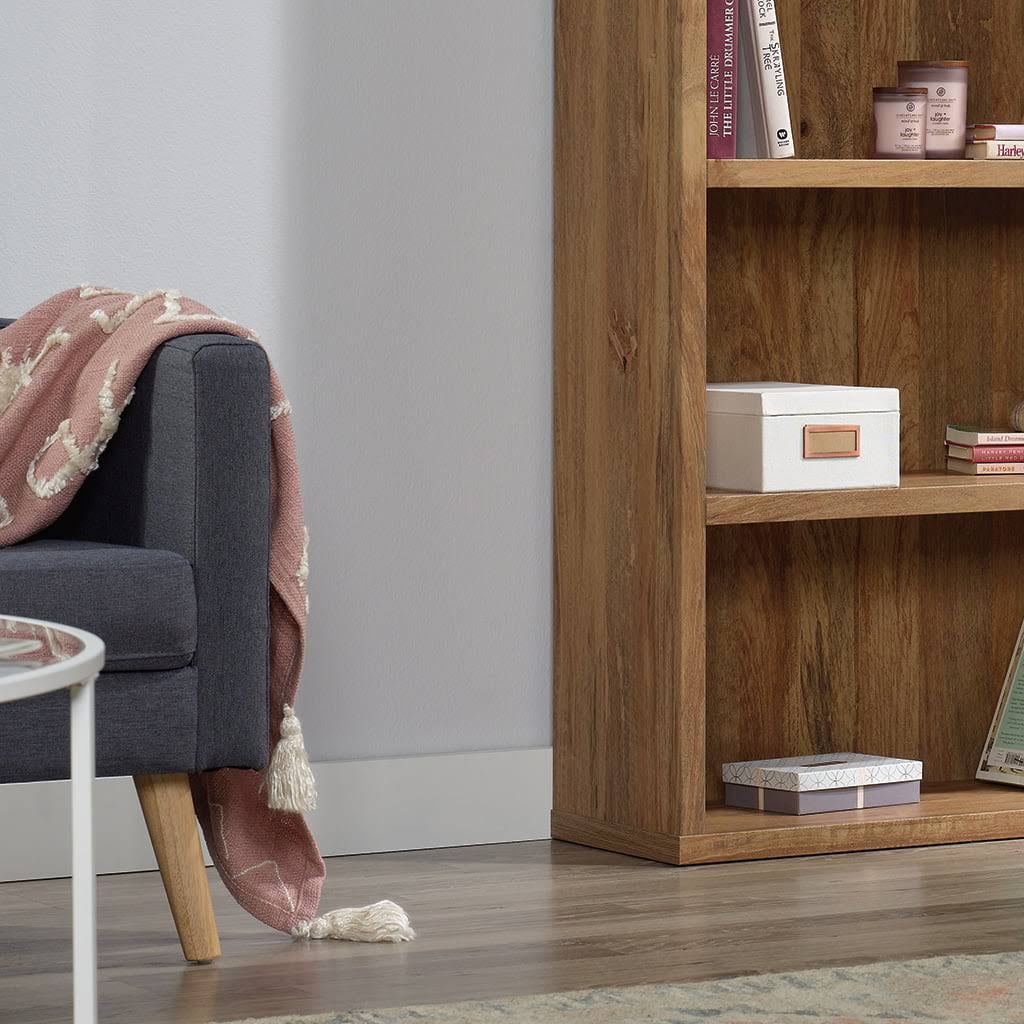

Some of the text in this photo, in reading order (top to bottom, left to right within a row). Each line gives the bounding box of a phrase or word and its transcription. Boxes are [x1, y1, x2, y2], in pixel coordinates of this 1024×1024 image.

[724, 7, 734, 67] DRUMMER
[762, 44, 773, 71] TREE
[709, 54, 720, 136] JOHN LE CARRÉ
[723, 70, 733, 110] LITTLE
[723, 112, 733, 137] THE
